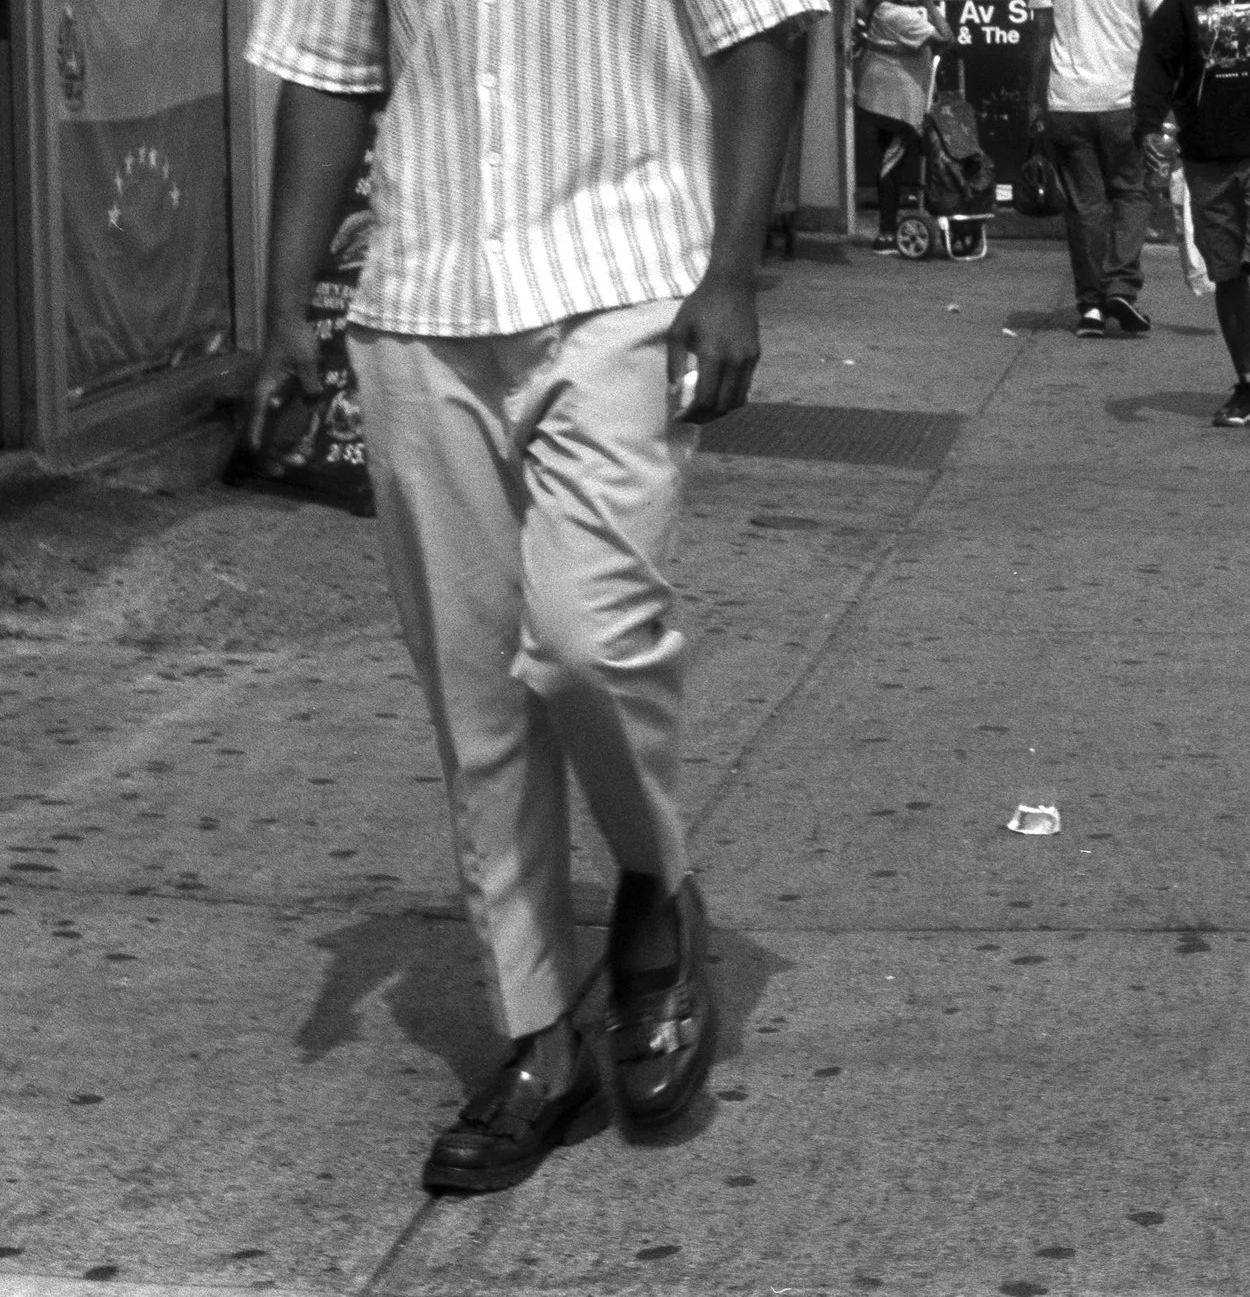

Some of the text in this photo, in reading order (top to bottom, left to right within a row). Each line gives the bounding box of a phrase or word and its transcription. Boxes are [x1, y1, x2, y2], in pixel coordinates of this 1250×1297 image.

[960, 0, 995, 24] Av
[957, 25, 1021, 45] & The
